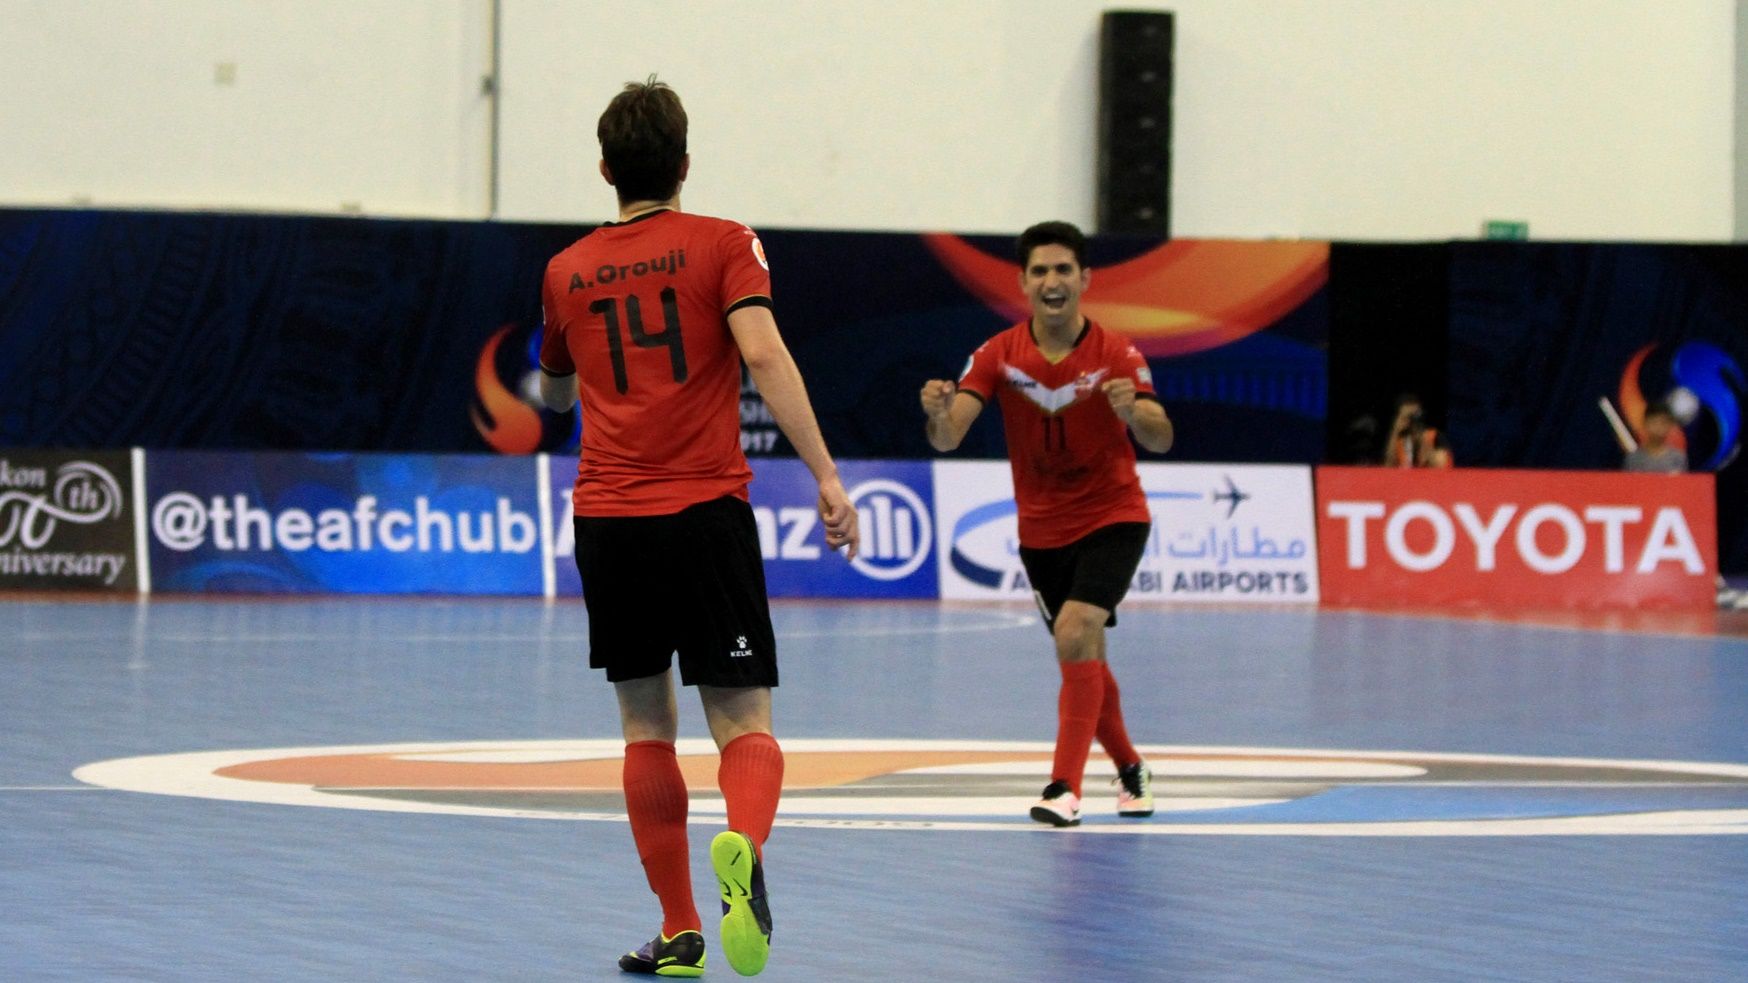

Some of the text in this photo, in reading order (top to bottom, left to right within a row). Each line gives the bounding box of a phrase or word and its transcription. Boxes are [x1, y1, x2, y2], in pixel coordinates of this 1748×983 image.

[568, 249, 686, 294] A.Orouji
[588, 286, 688, 396] 14
[152, 493, 536, 551] @theafchub
[1168, 526, 1306, 568] مطارات
[1327, 500, 1705, 575] TOYOTA
[1172, 571, 1309, 594] AIRPORTS
